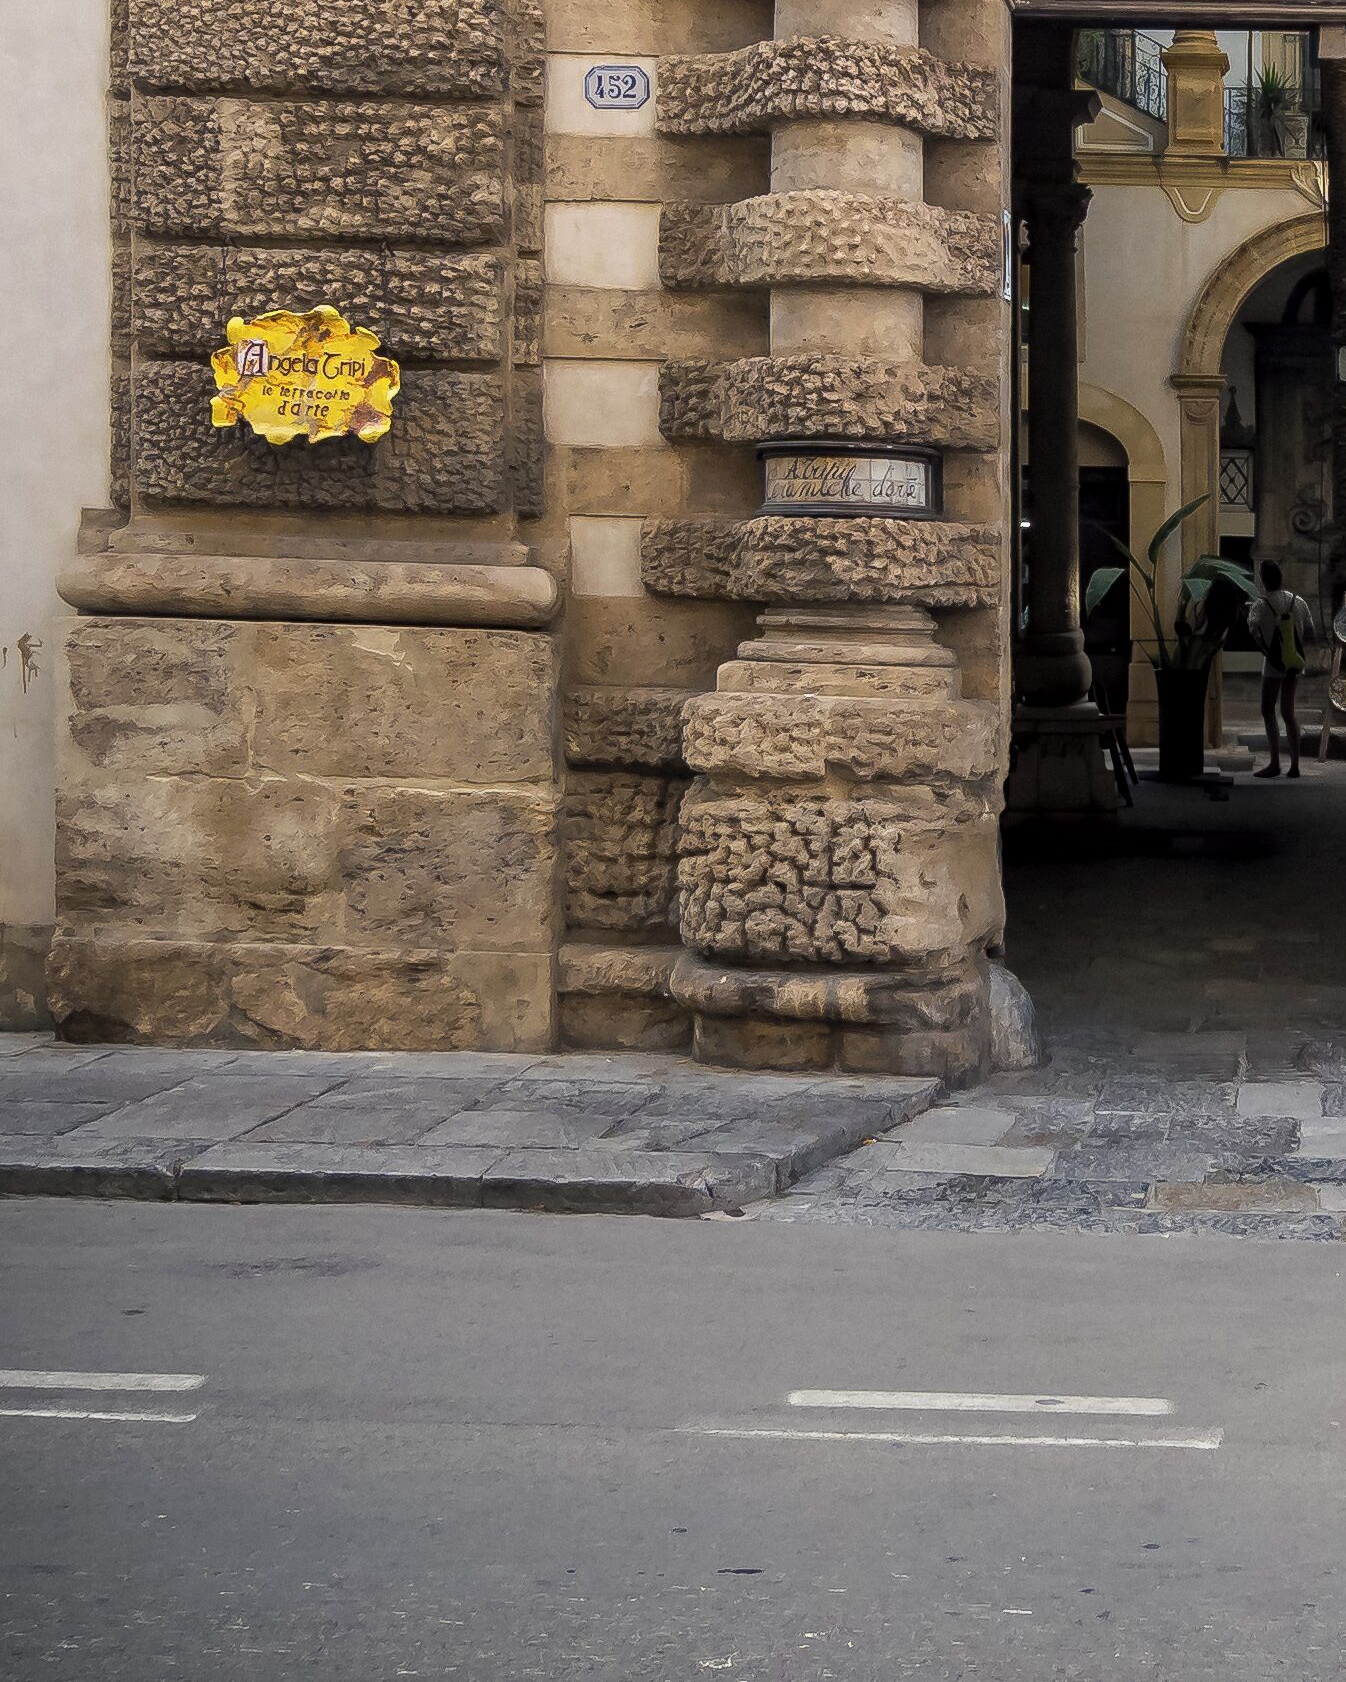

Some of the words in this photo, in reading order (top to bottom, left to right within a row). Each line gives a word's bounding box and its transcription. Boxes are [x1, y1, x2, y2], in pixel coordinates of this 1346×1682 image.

[594, 74, 637, 99] 452
[241, 341, 319, 381] Angela
[322, 351, 366, 380] Tripi
[261, 385, 273, 397] le
[279, 386, 351, 401] terracotte
